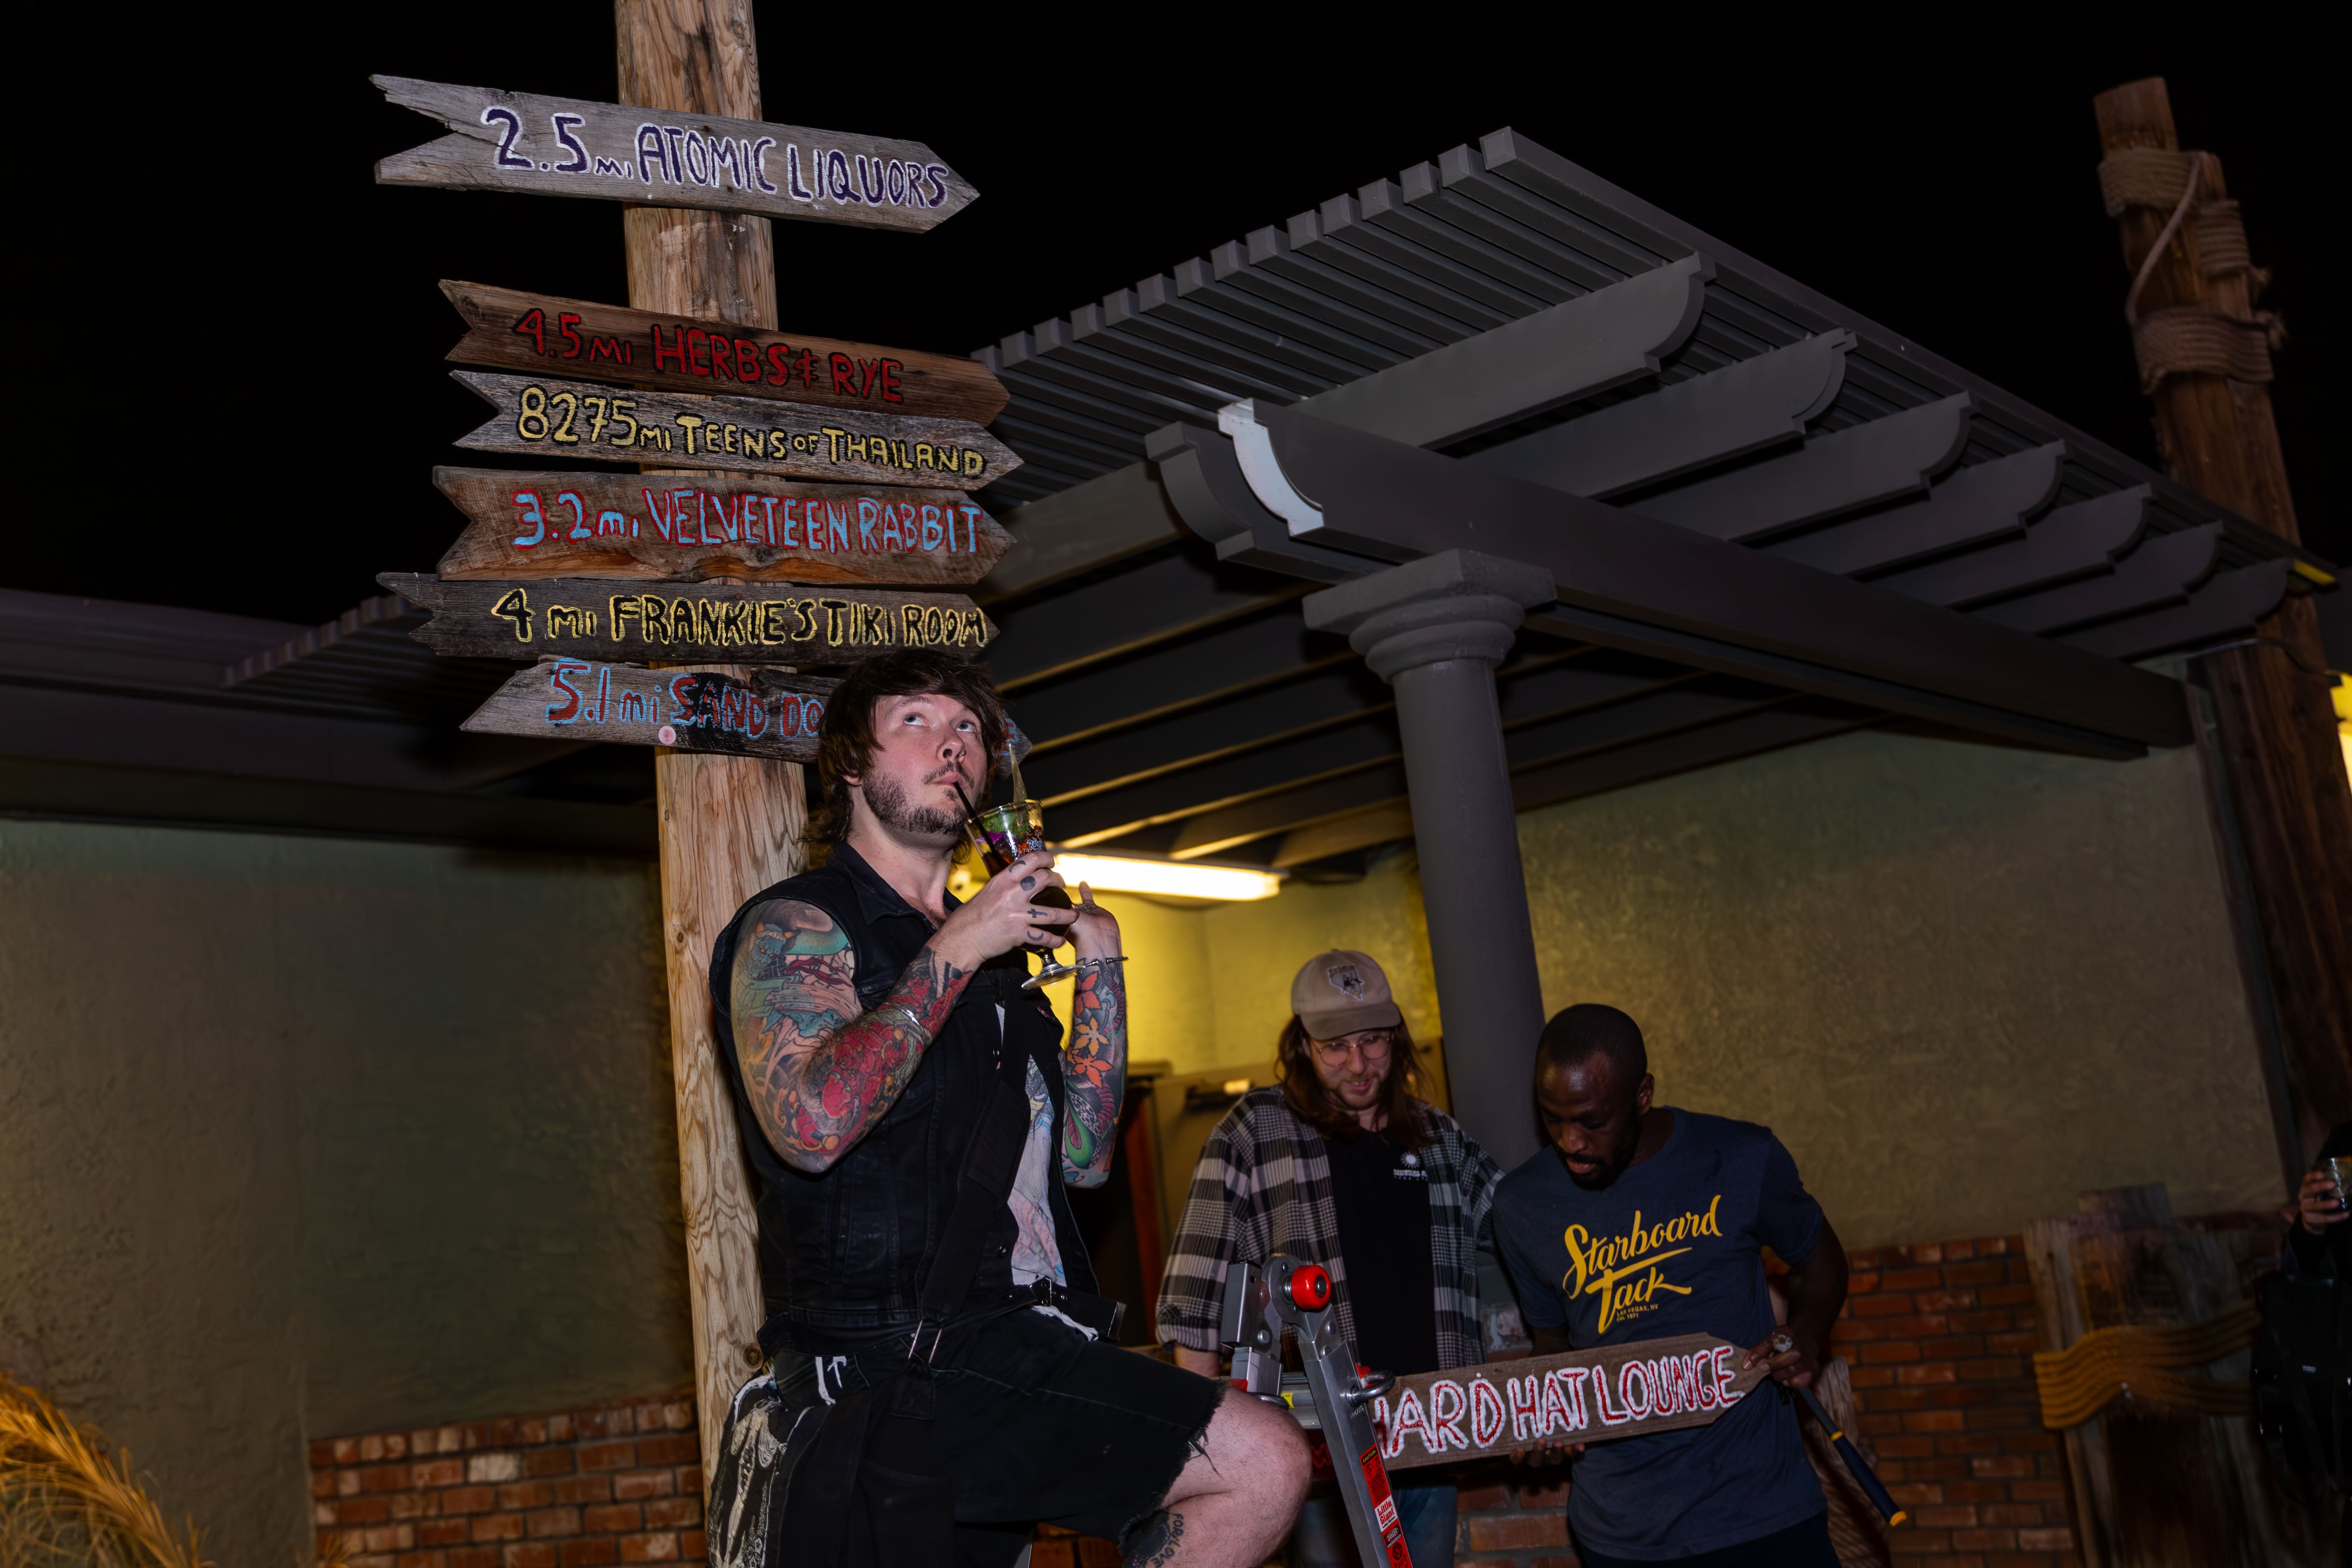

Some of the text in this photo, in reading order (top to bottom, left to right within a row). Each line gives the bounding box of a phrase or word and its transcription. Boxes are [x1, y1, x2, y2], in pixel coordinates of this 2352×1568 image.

[634, 122, 777, 194] ATOMIC
[787, 144, 949, 209] LIQUORS
[512, 308, 584, 359] 4.5
[651, 324, 790, 387] HERBS
[828, 352, 904, 404] RYE
[517, 384, 640, 447] 8275
[675, 412, 787, 461] TEENS
[821, 426, 986, 478] THAILAND
[642, 487, 853, 555] VELVETEEN
[856, 496, 986, 555] RABBIT
[491, 588, 536, 642] 4
[609, 594, 817, 647] FRANKIE'S
[819, 598, 897, 646] TIKI
[902, 603, 988, 647] ROOM
[545, 658, 824, 739] 5.1 mi SAND DO
[1563, 1195, 1723, 1299] Starboard
[1585, 1247, 1692, 1334] Tack
[1507, 1367, 1589, 1440] HAT
[1592, 1345, 1746, 1425] LOUNGE
[1362, 1449, 1376, 1463] CAUTION
[1377, 1500, 1392, 1516] Little
[1379, 1508, 1395, 1525] Giant
